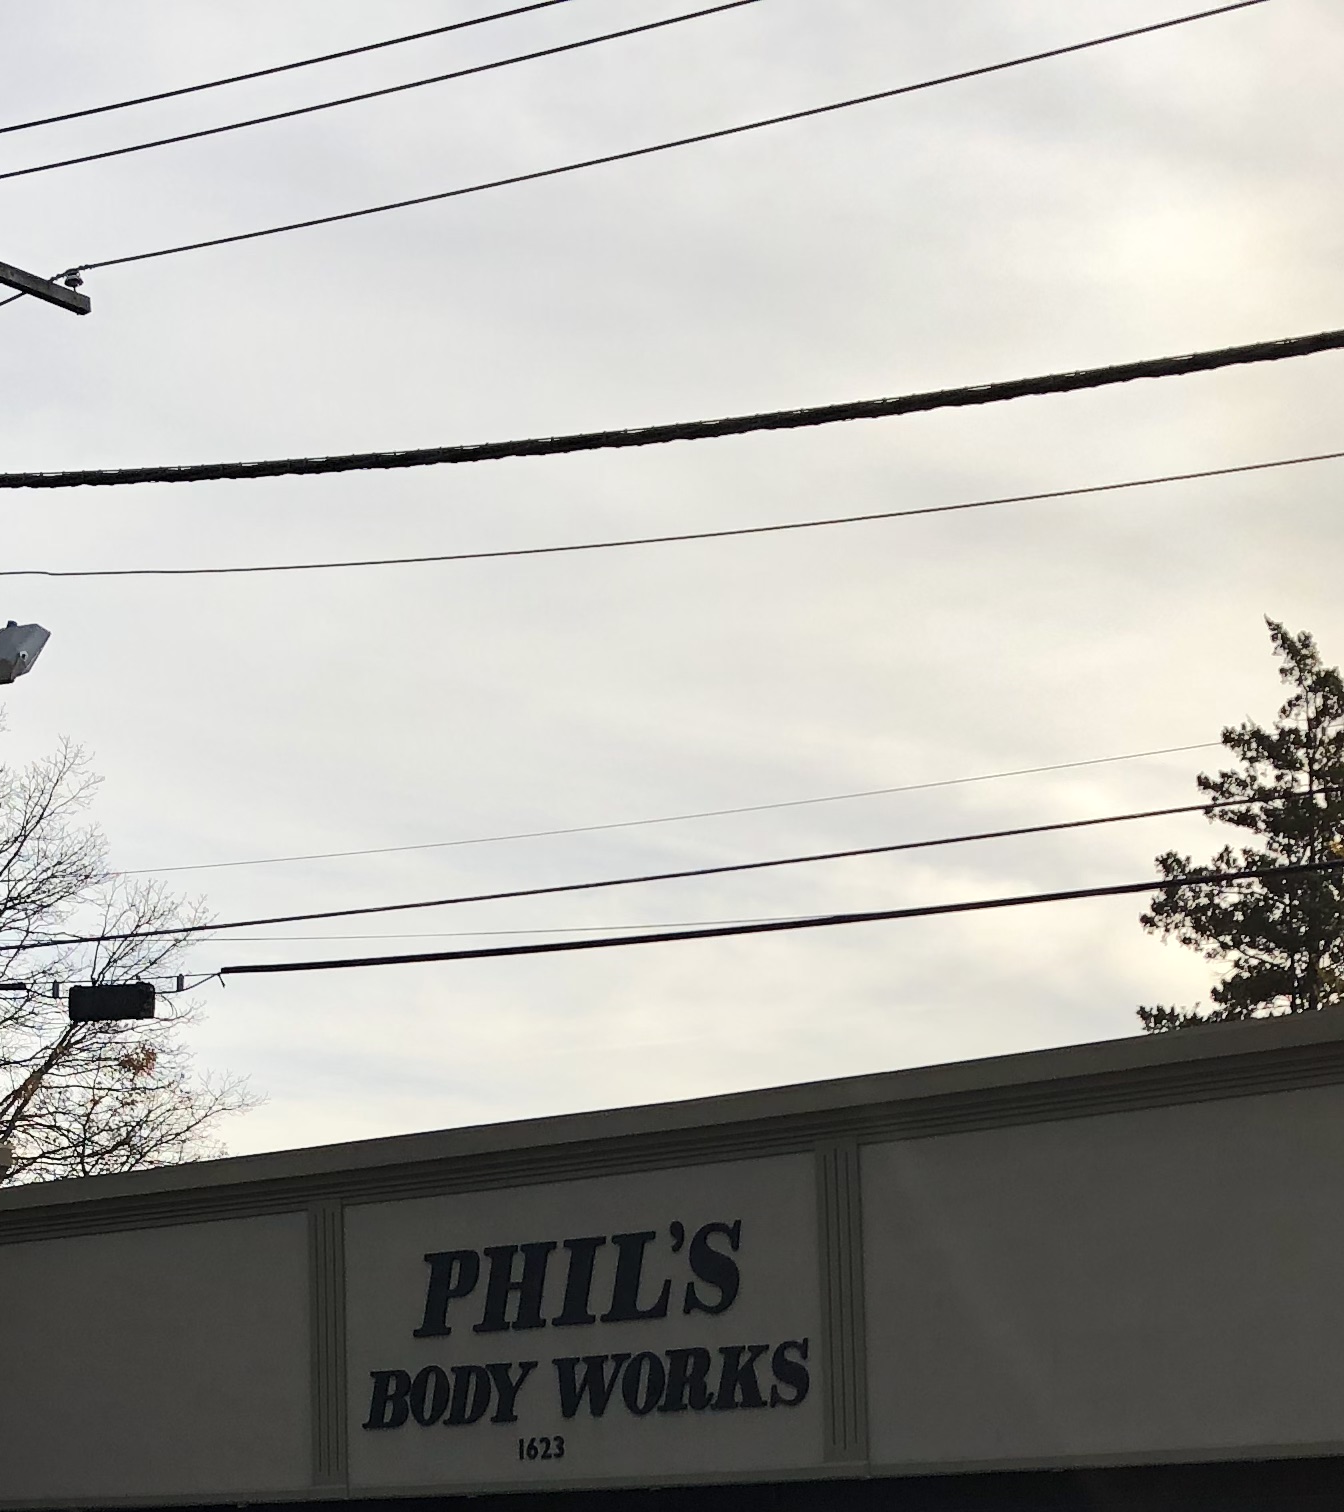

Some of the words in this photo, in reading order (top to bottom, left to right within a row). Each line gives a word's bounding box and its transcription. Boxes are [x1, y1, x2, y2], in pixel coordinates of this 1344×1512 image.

[413, 1220, 742, 1337] PHIL'S
[362, 1361, 538, 1429] BODY
[552, 1338, 810, 1418] WORKS
[519, 1435, 565, 1460] 1623
